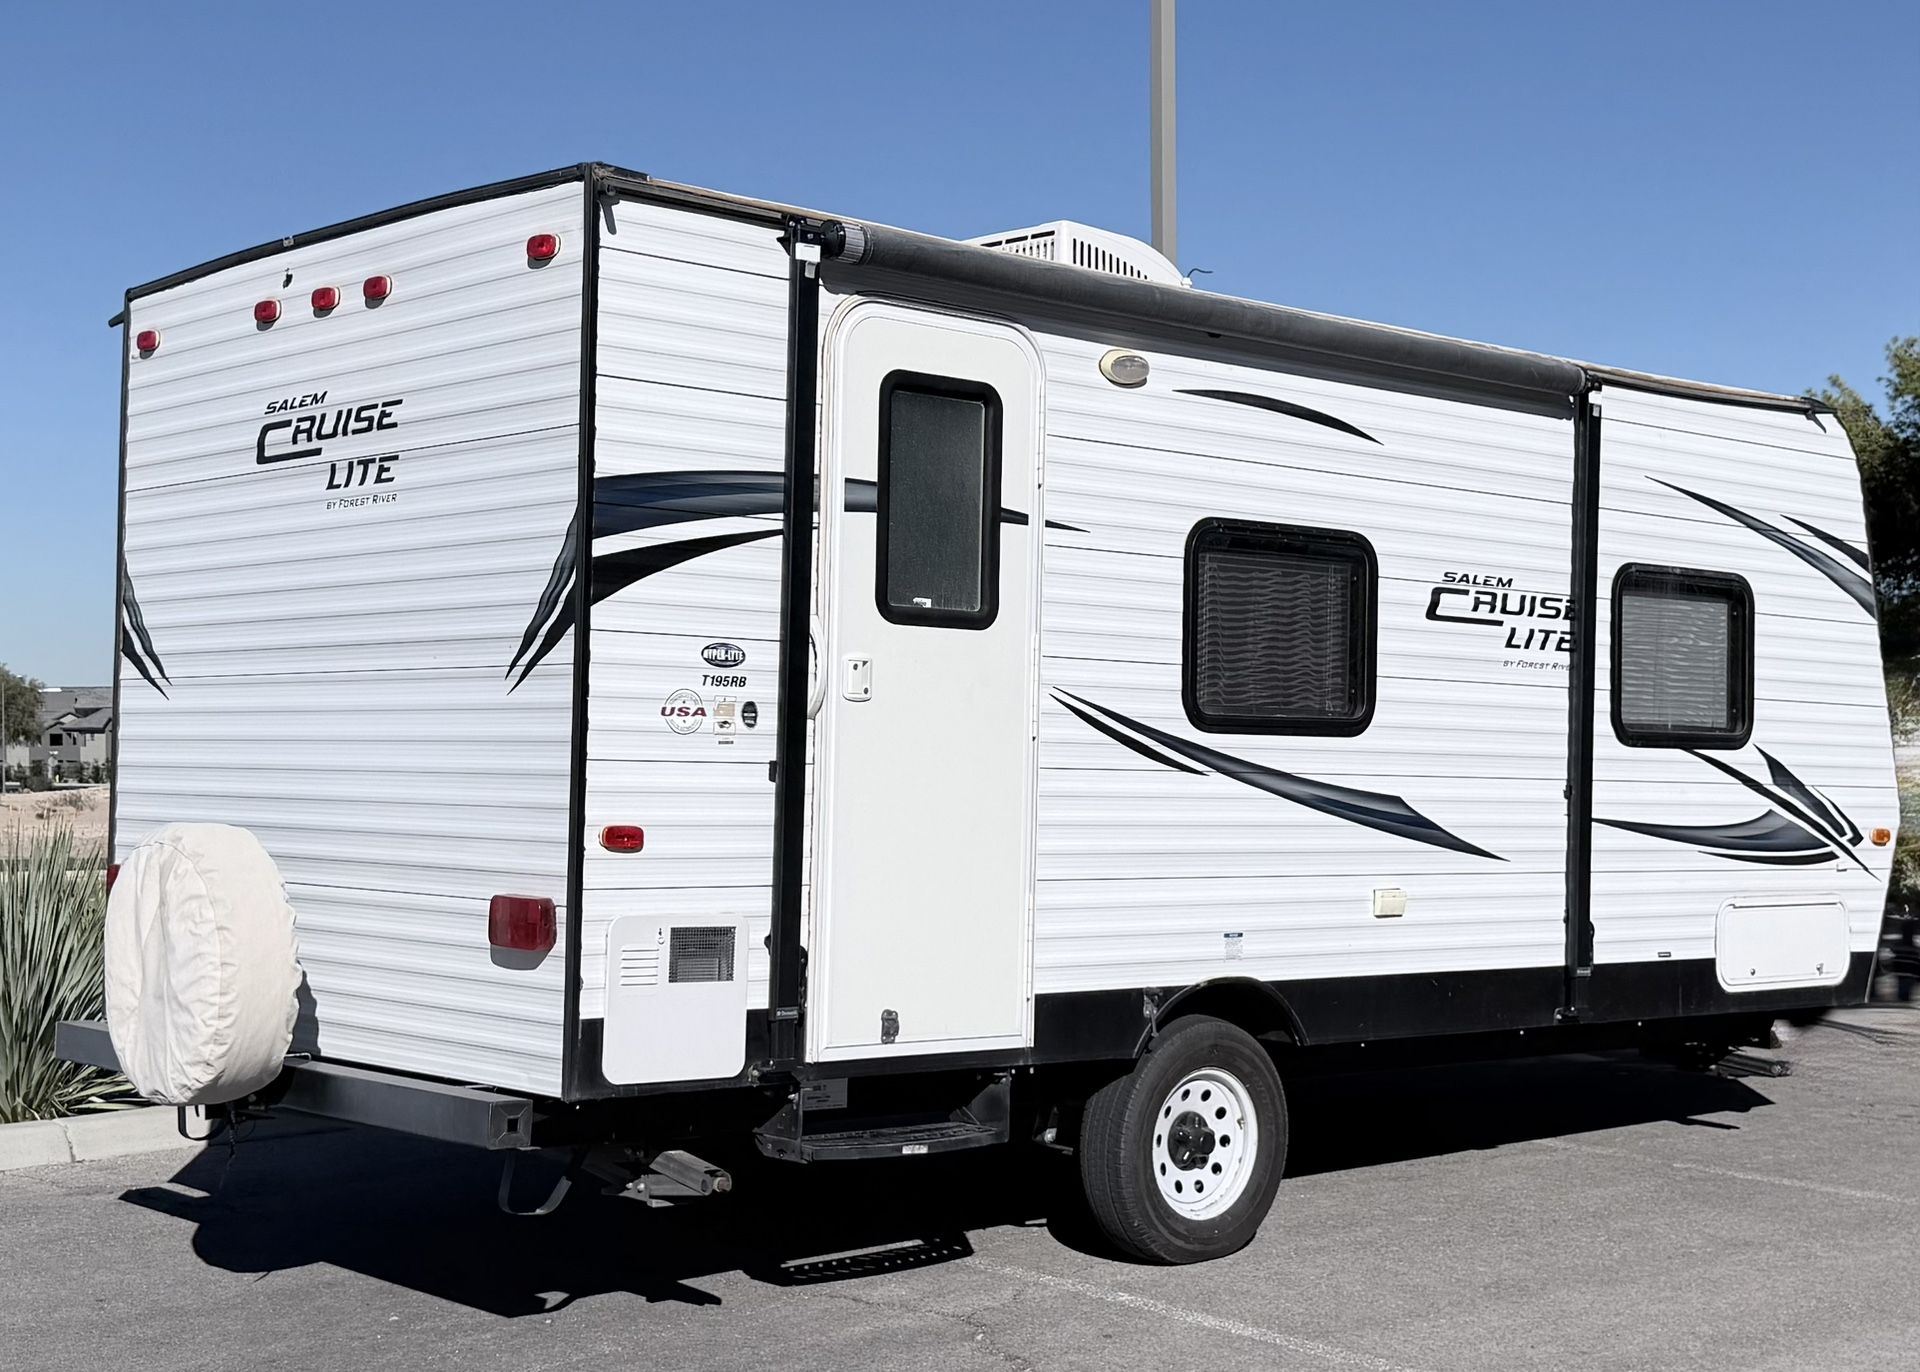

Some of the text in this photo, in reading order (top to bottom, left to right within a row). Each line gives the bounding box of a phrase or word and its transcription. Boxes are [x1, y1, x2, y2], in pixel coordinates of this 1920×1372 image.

[264, 391, 328, 415] SALEM
[256, 399, 404, 465] CRUISE
[325, 454, 400, 490] LITE
[326, 493, 398, 510] BY FOREST RIVER
[1442, 571, 1514, 588] SALEM
[1504, 627, 1575, 652] LITE
[702, 674, 747, 688] T195RB
[660, 706, 707, 717] USA
